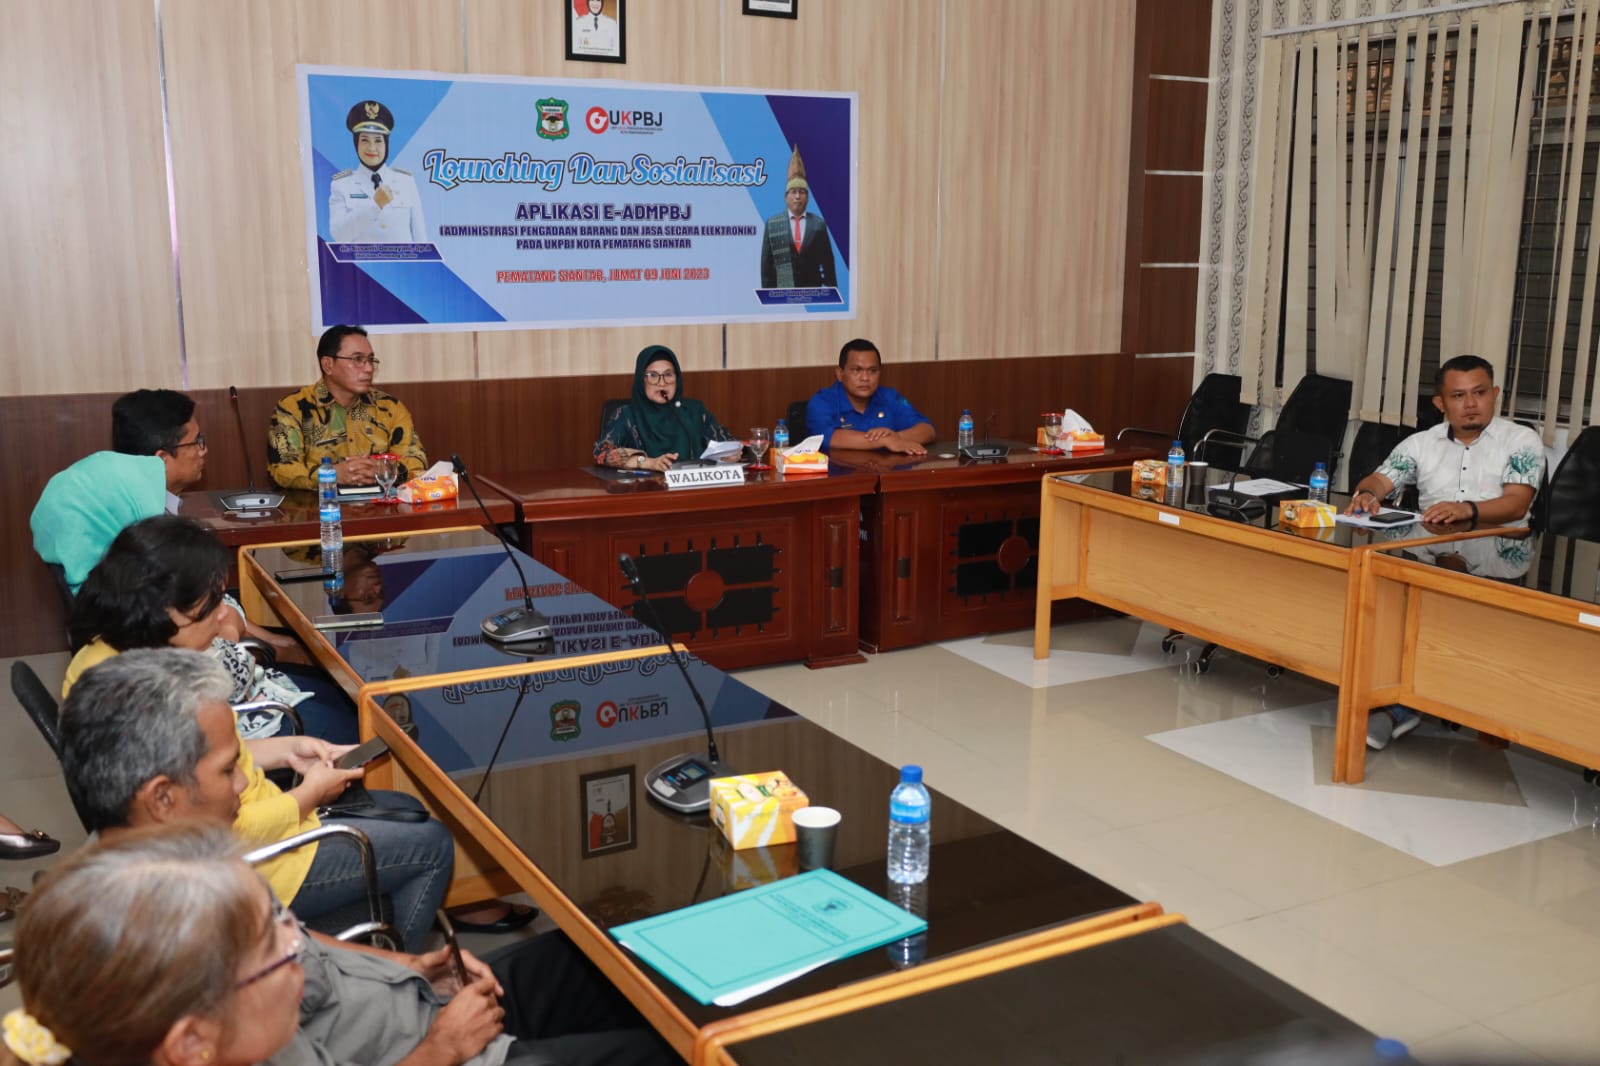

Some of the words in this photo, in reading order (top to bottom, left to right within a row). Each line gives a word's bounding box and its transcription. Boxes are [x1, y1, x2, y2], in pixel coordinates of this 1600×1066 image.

[609, 109, 663, 127] UKPBJ
[568, 152, 629, 186] Dan
[629, 153, 767, 187] Sosialisasi
[515, 203, 600, 221] APLIKASI
[603, 203, 692, 221] E-ADMPBJ
[520, 225, 578, 237] PENGADAAN
[579, 225, 618, 237] BARANG
[619, 225, 639, 237] DAN
[641, 225, 663, 237] JASA
[664, 225, 700, 237] SECARA
[516, 238, 543, 250] PADA
[576, 238, 601, 250] KOTA
[603, 238, 652, 249] PEMATANG
[653, 238, 692, 249] SIANTAR
[496, 269, 556, 283] PEMATANG
[609, 267, 642, 281] JUMAT
[644, 267, 658, 281] 09
[660, 267, 681, 281] JUNI
[668, 470, 742, 484] WALIKOTA
